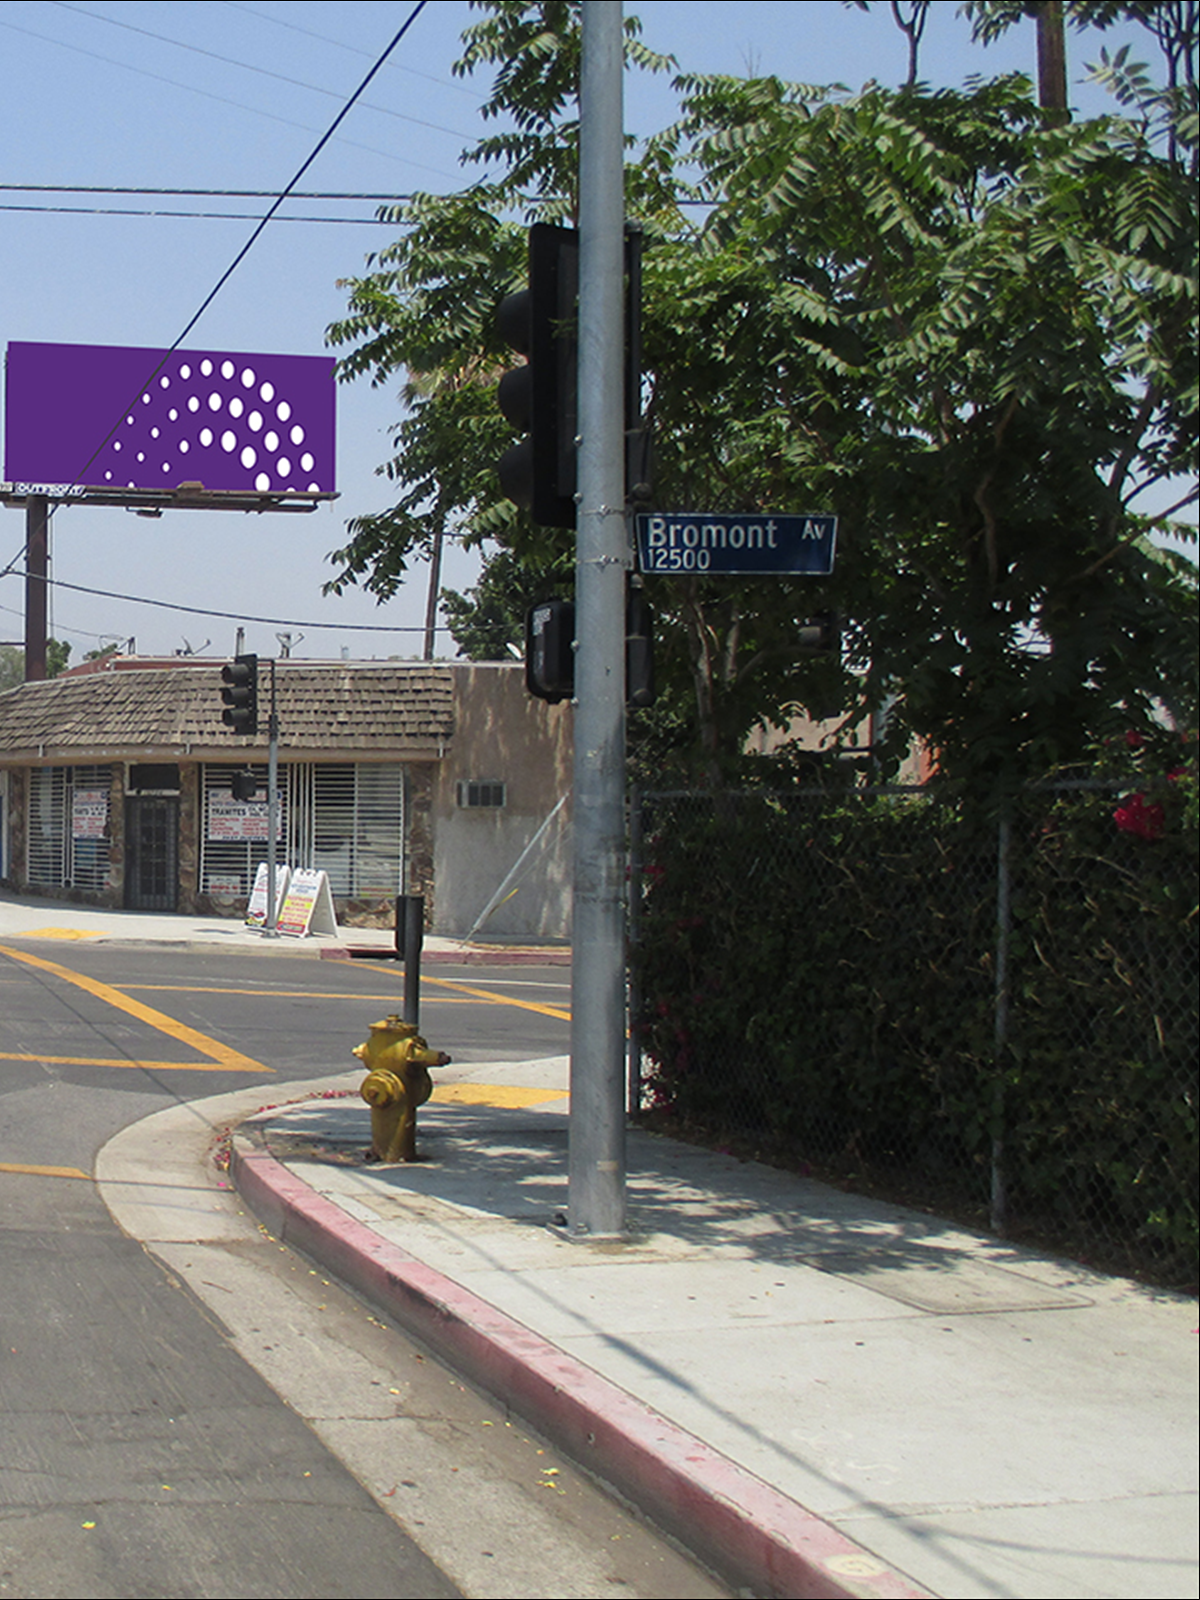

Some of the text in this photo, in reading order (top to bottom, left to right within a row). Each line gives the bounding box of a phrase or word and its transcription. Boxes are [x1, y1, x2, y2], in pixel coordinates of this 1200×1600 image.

[648, 517, 826, 548] Bromont Av
[648, 548, 711, 570] 12500
